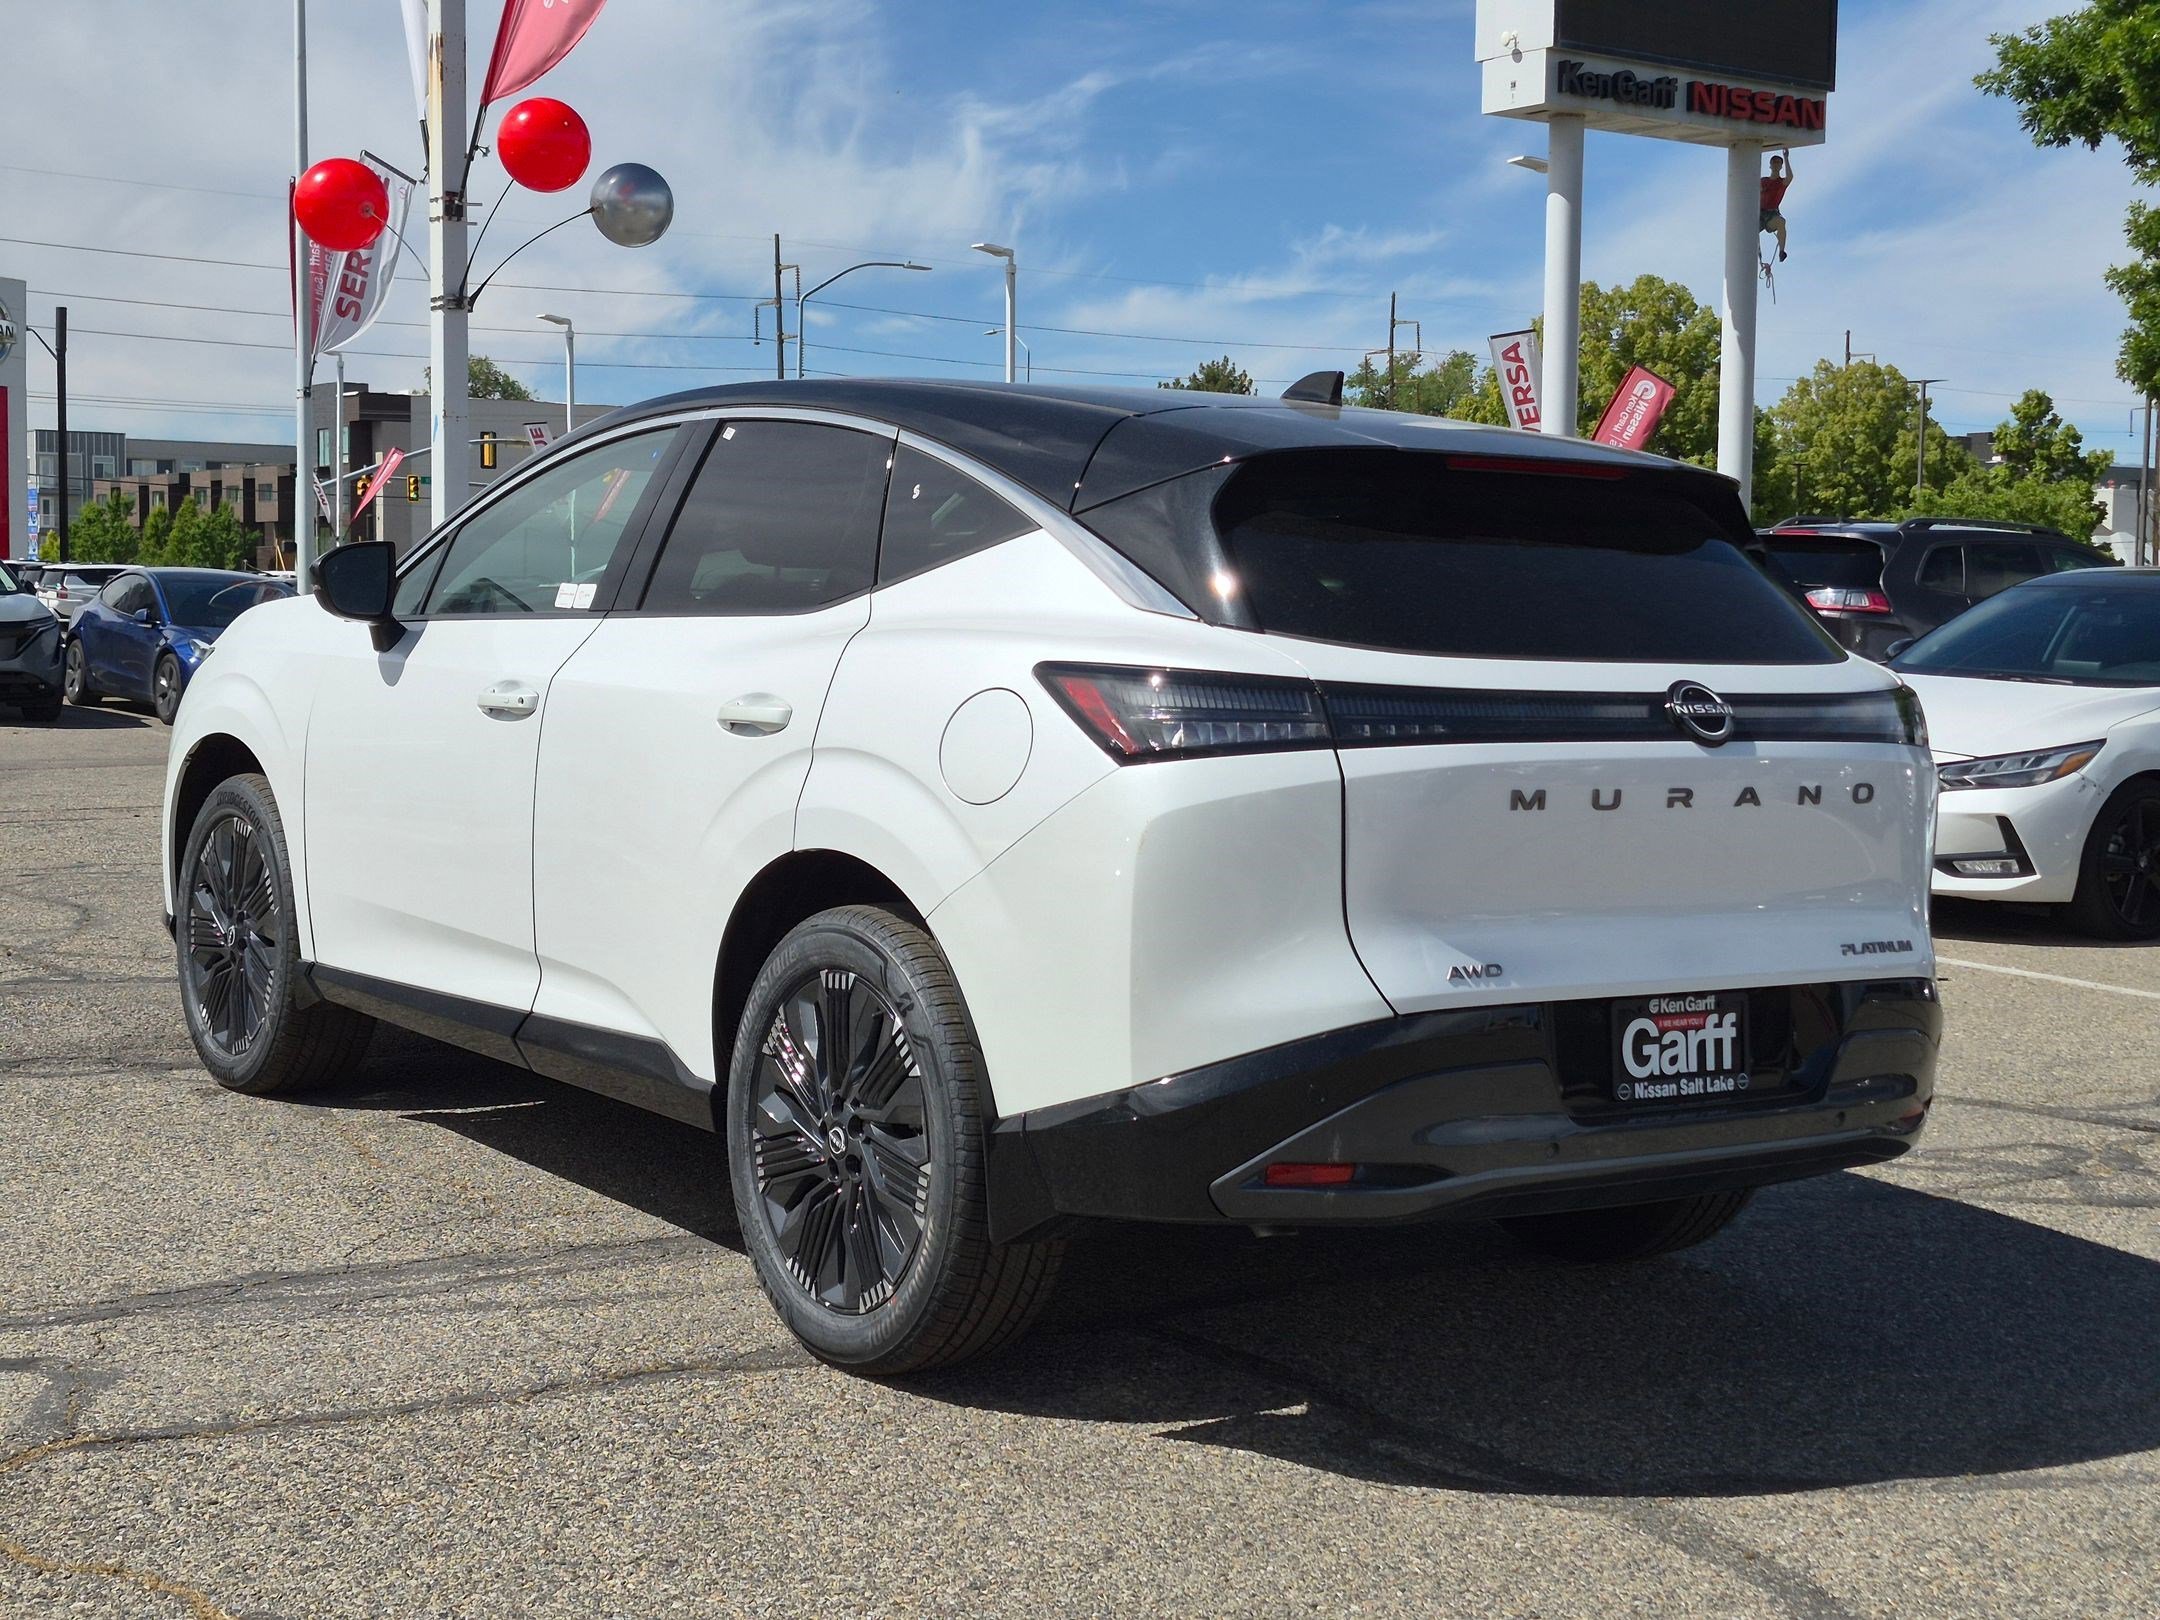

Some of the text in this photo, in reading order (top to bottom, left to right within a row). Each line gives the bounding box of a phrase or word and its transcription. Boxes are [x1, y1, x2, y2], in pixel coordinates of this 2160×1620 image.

[1558, 60, 1825, 130] Ken Garff NISSAN
[1674, 703, 1734, 714] NISSAN
[1510, 782, 1875, 811] MURANO
[1840, 939, 1913, 956] PLATINUM
[1446, 963, 1503, 981] AWD
[1660, 995, 1716, 1014] Ken Garff
[1622, 1012, 1737, 1079] Garff
[1634, 1075, 1735, 1100] Nissan Salt Lake
